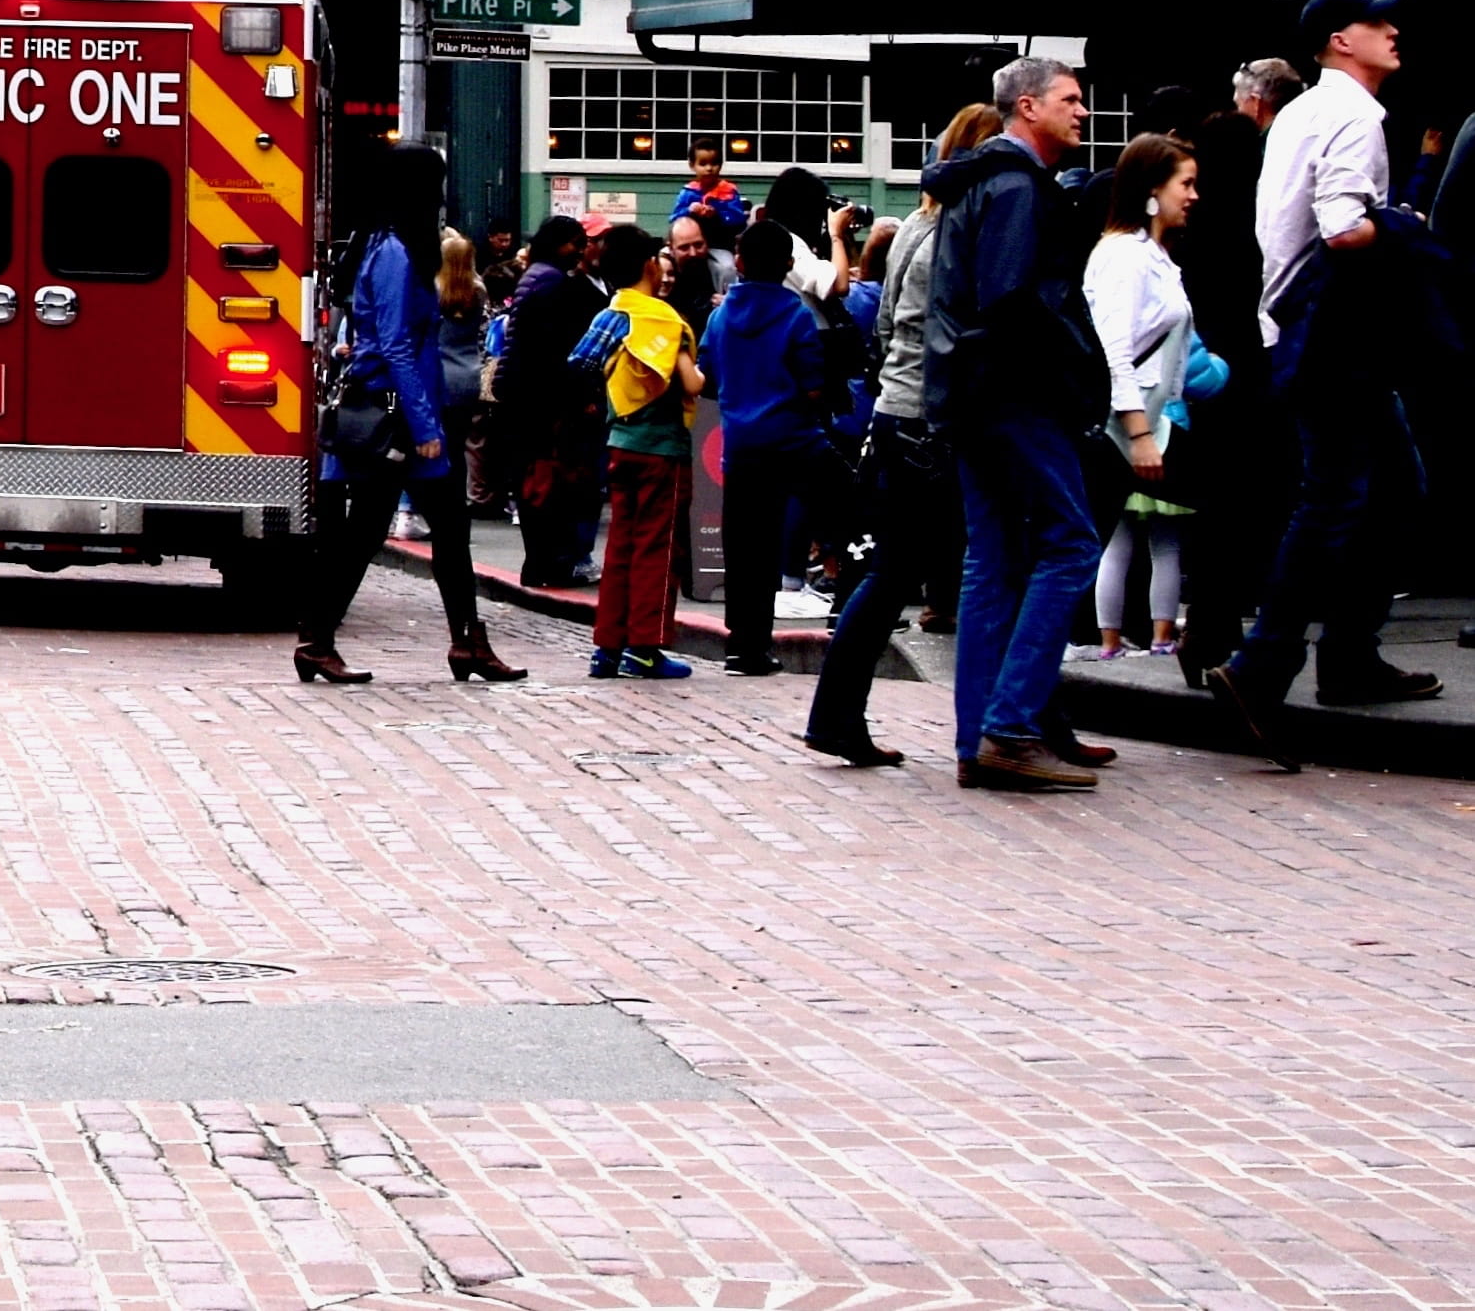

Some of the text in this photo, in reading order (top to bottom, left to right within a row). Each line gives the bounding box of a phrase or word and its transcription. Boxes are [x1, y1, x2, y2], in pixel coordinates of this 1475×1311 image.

[23, 37, 72, 60] FIRE
[80, 39, 143, 62] DEPT.
[436, 41, 527, 56] Pike Place Market
[69, 69, 182, 127] ONE
[557, 205, 578, 215] ANY
